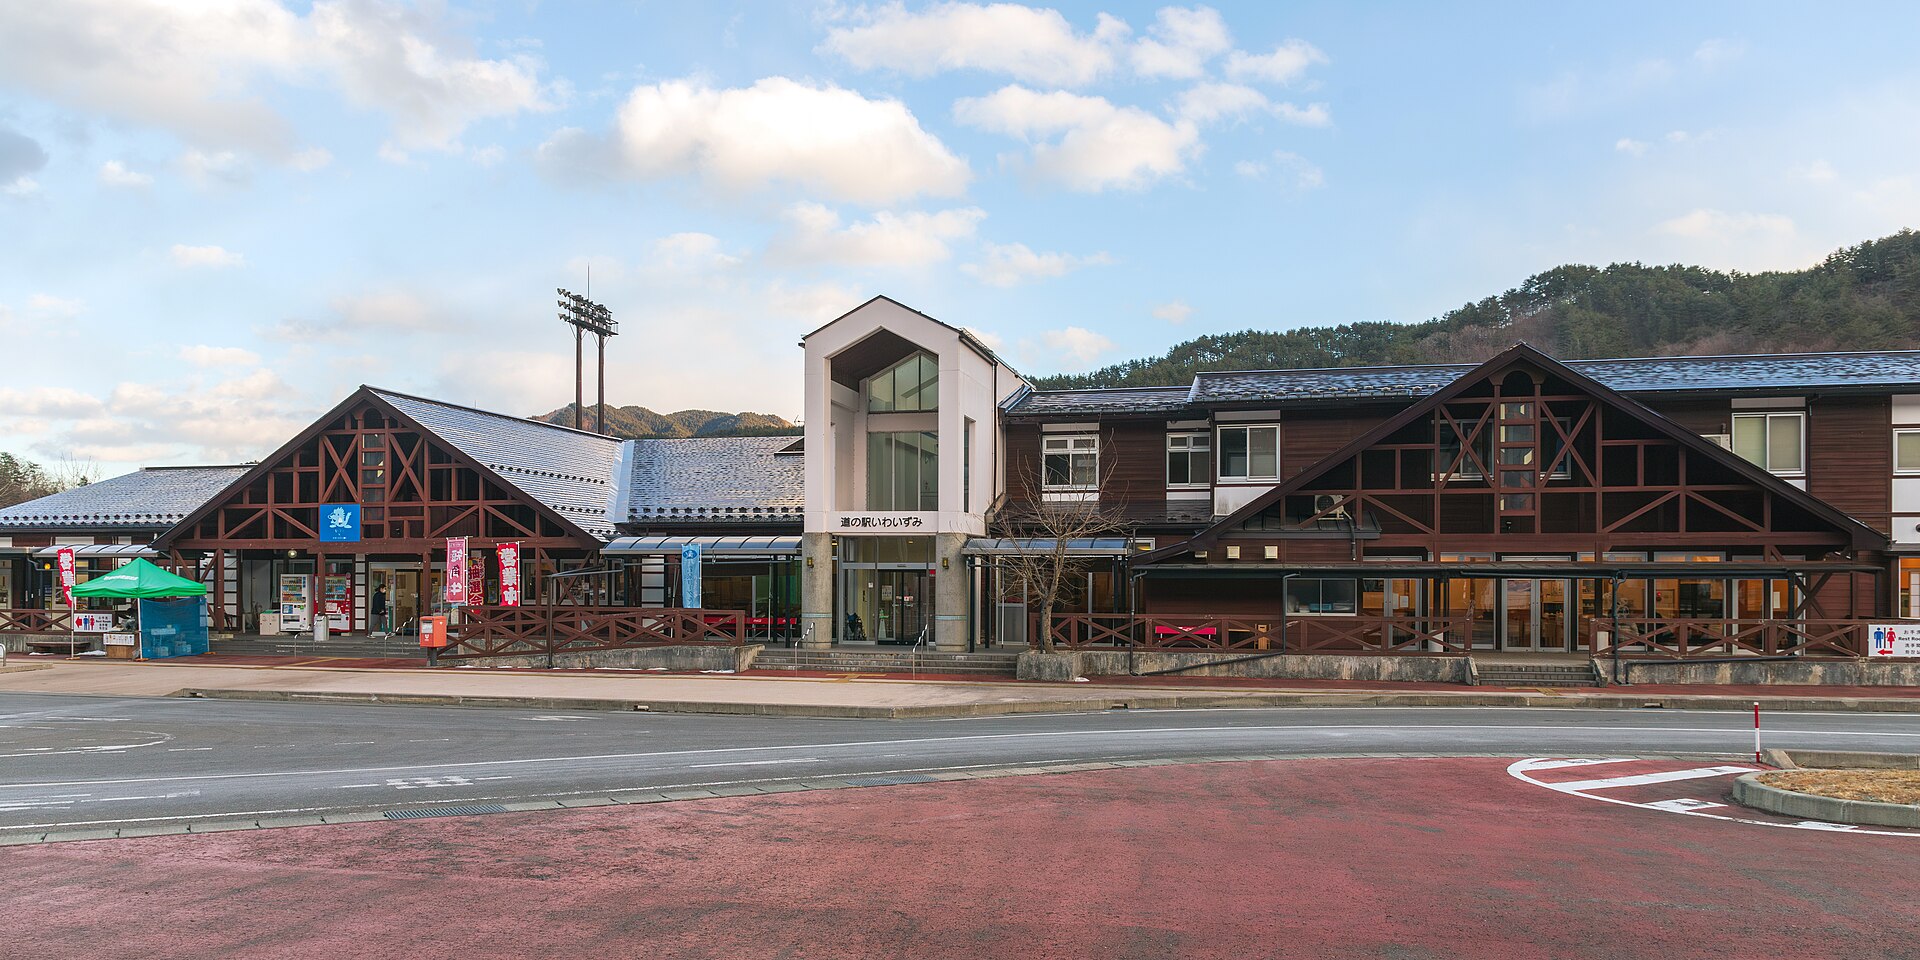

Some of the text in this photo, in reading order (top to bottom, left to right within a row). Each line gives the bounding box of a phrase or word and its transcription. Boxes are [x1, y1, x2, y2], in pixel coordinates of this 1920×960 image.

[841, 517, 922, 527] 道の駅いわいずみ
[501, 547, 517, 606] 営業中
